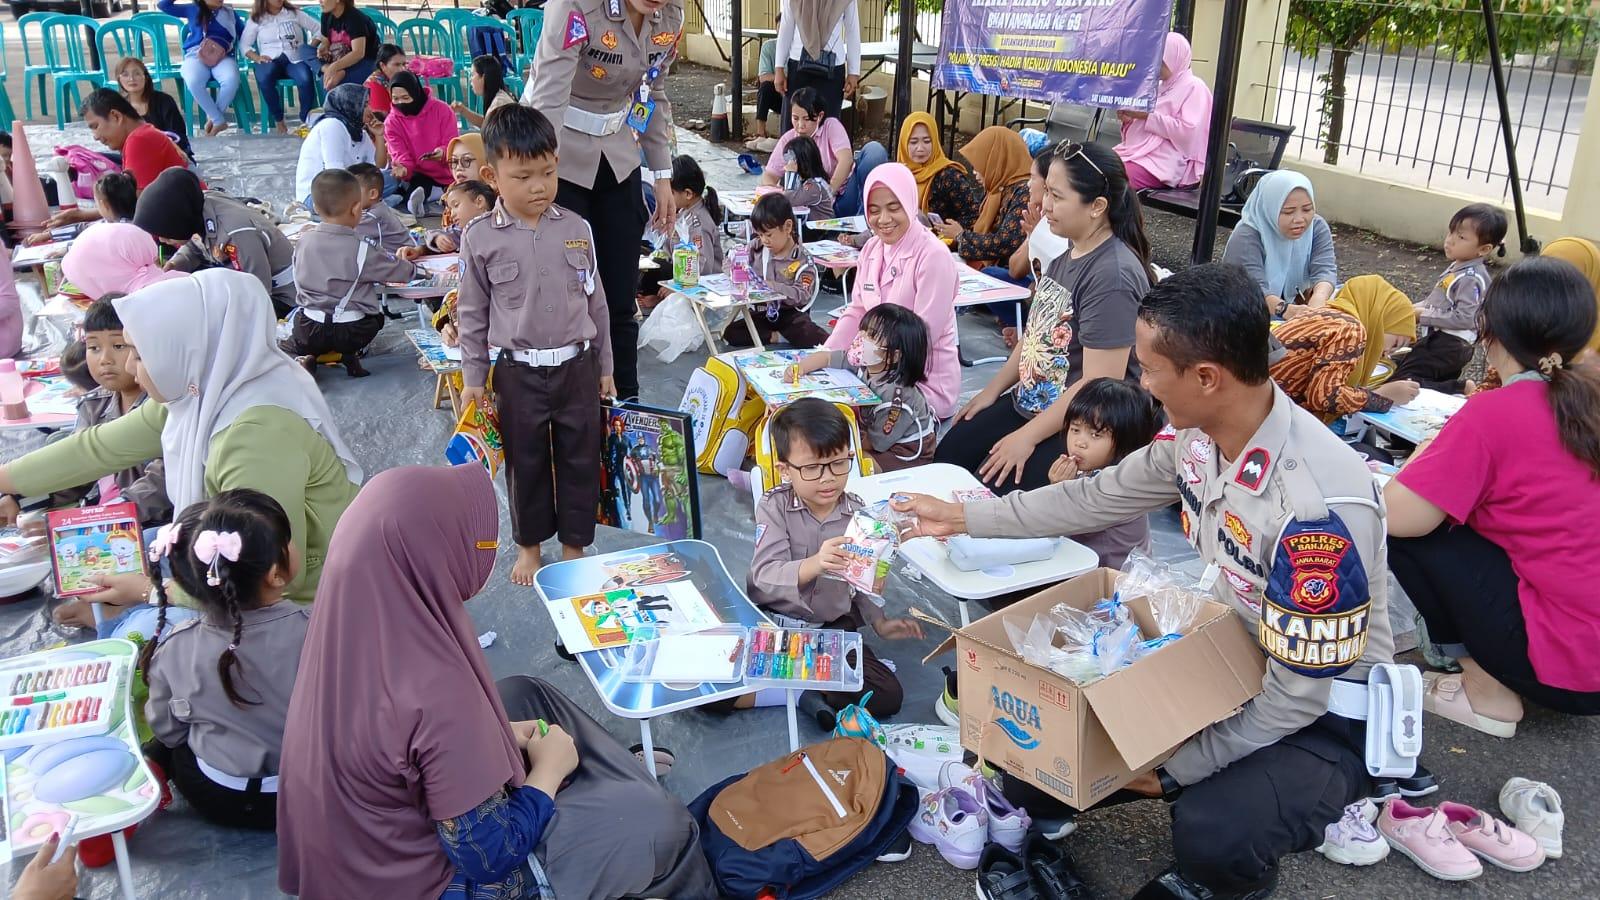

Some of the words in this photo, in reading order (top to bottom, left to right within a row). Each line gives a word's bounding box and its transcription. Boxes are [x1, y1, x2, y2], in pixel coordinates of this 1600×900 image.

[1000, 55, 1021, 69] HADIR
[1023, 56, 1052, 71] MENUJU
[1052, 59, 1097, 75] INDONESIA
[1289, 535, 1345, 549] POLRES
[1297, 543, 1336, 552] BANJAR
[1218, 527, 1264, 578] POLRI
[1296, 556, 1314, 565] JAWA
[1315, 557, 1336, 566] BARAT
[1265, 603, 1367, 641] KANIT
[991, 685, 1042, 730] AQUA
